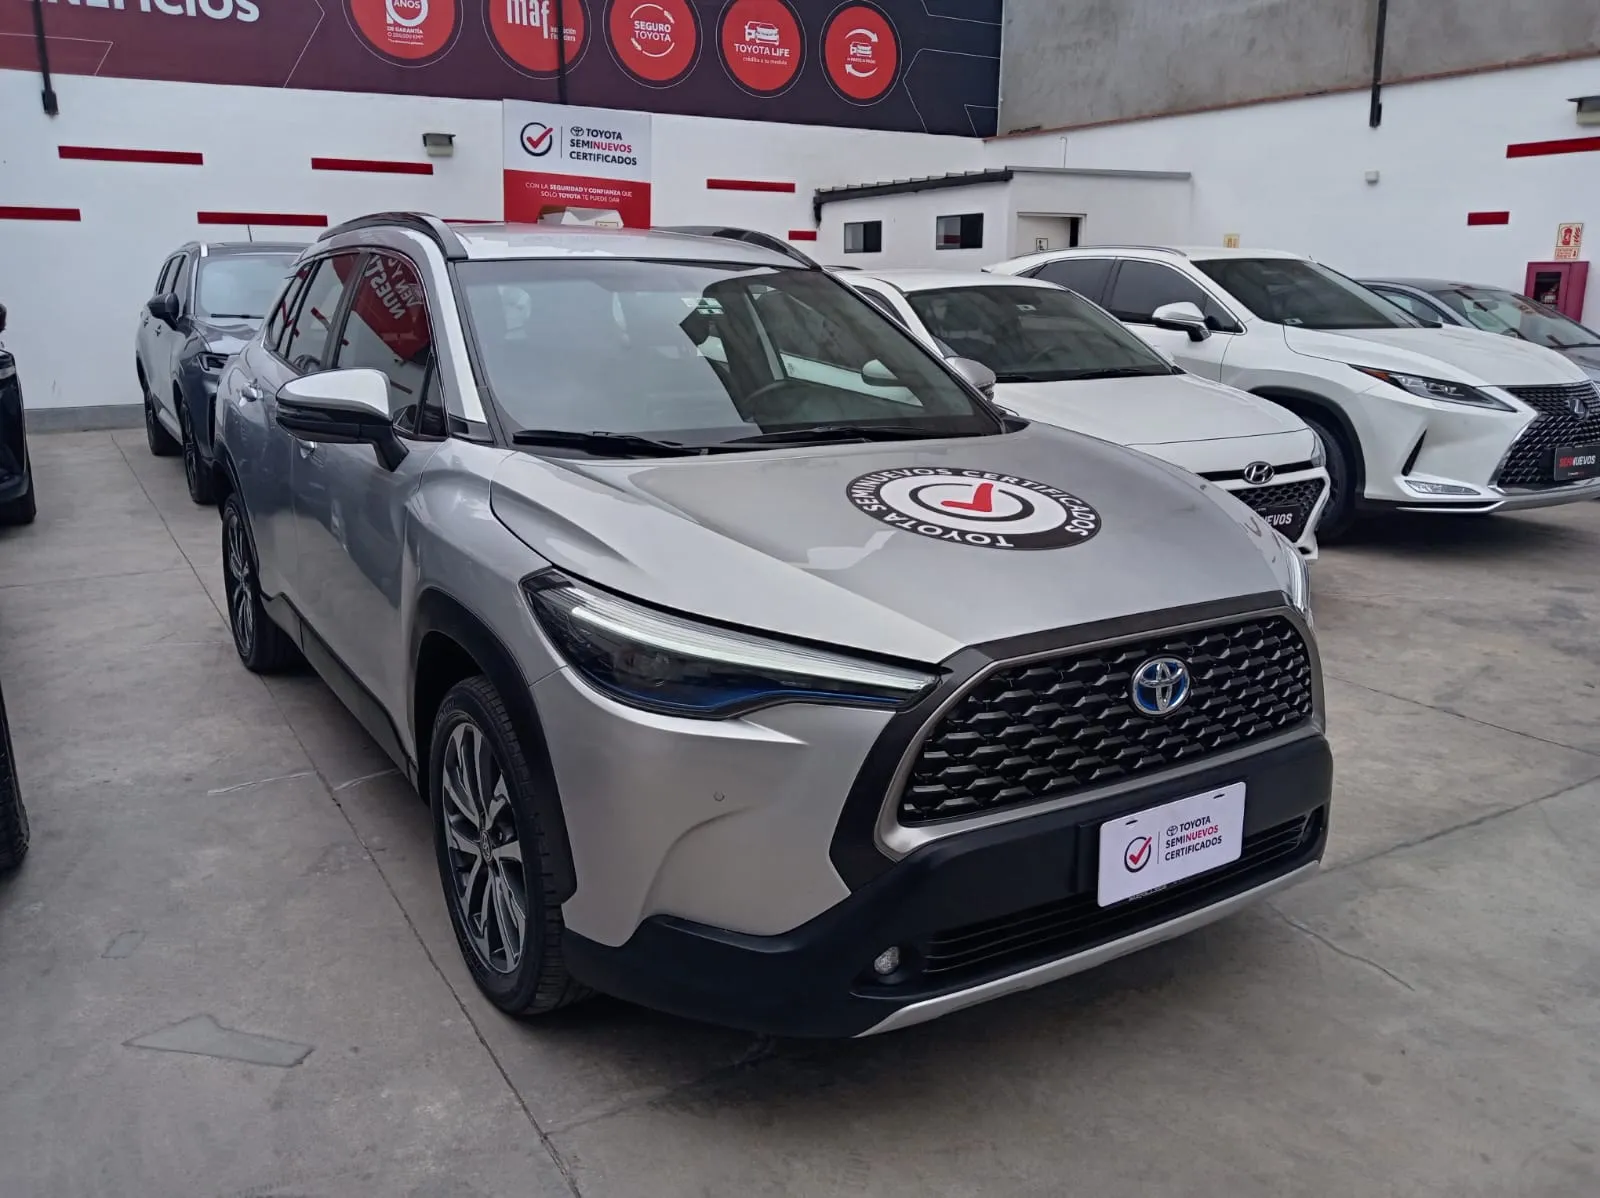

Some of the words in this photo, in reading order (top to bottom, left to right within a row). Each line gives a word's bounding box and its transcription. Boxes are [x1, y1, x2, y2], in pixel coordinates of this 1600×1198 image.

[506, 0, 549, 39] maf
[634, 20, 671, 33] SEGURO
[634, 30, 671, 42] TOYOTA
[734, 43, 770, 55] TOYOTA
[772, 48, 790, 57] LIFE
[586, 128, 623, 140] TOYOTA
[570, 139, 632, 154] SEMINUEVOS
[569, 151, 637, 166] CERTIFICADOS
[550, 184, 583, 193] SEGURIDAD
[589, 187, 621, 196] CONFIANZA
[622, 190, 633, 198] QUE
[559, 192, 581, 200] TOYOTA
[850, 468, 952, 512] SEMINUEVOS
[962, 469, 1096, 537] CERTIFICADOS
[882, 512, 1015, 548] TOYOTA
[1179, 816, 1211, 833] TOYOTA
[1165, 825, 1219, 849] SEMINUEVOS
[1164, 835, 1223, 861] CERTIFICADOS
